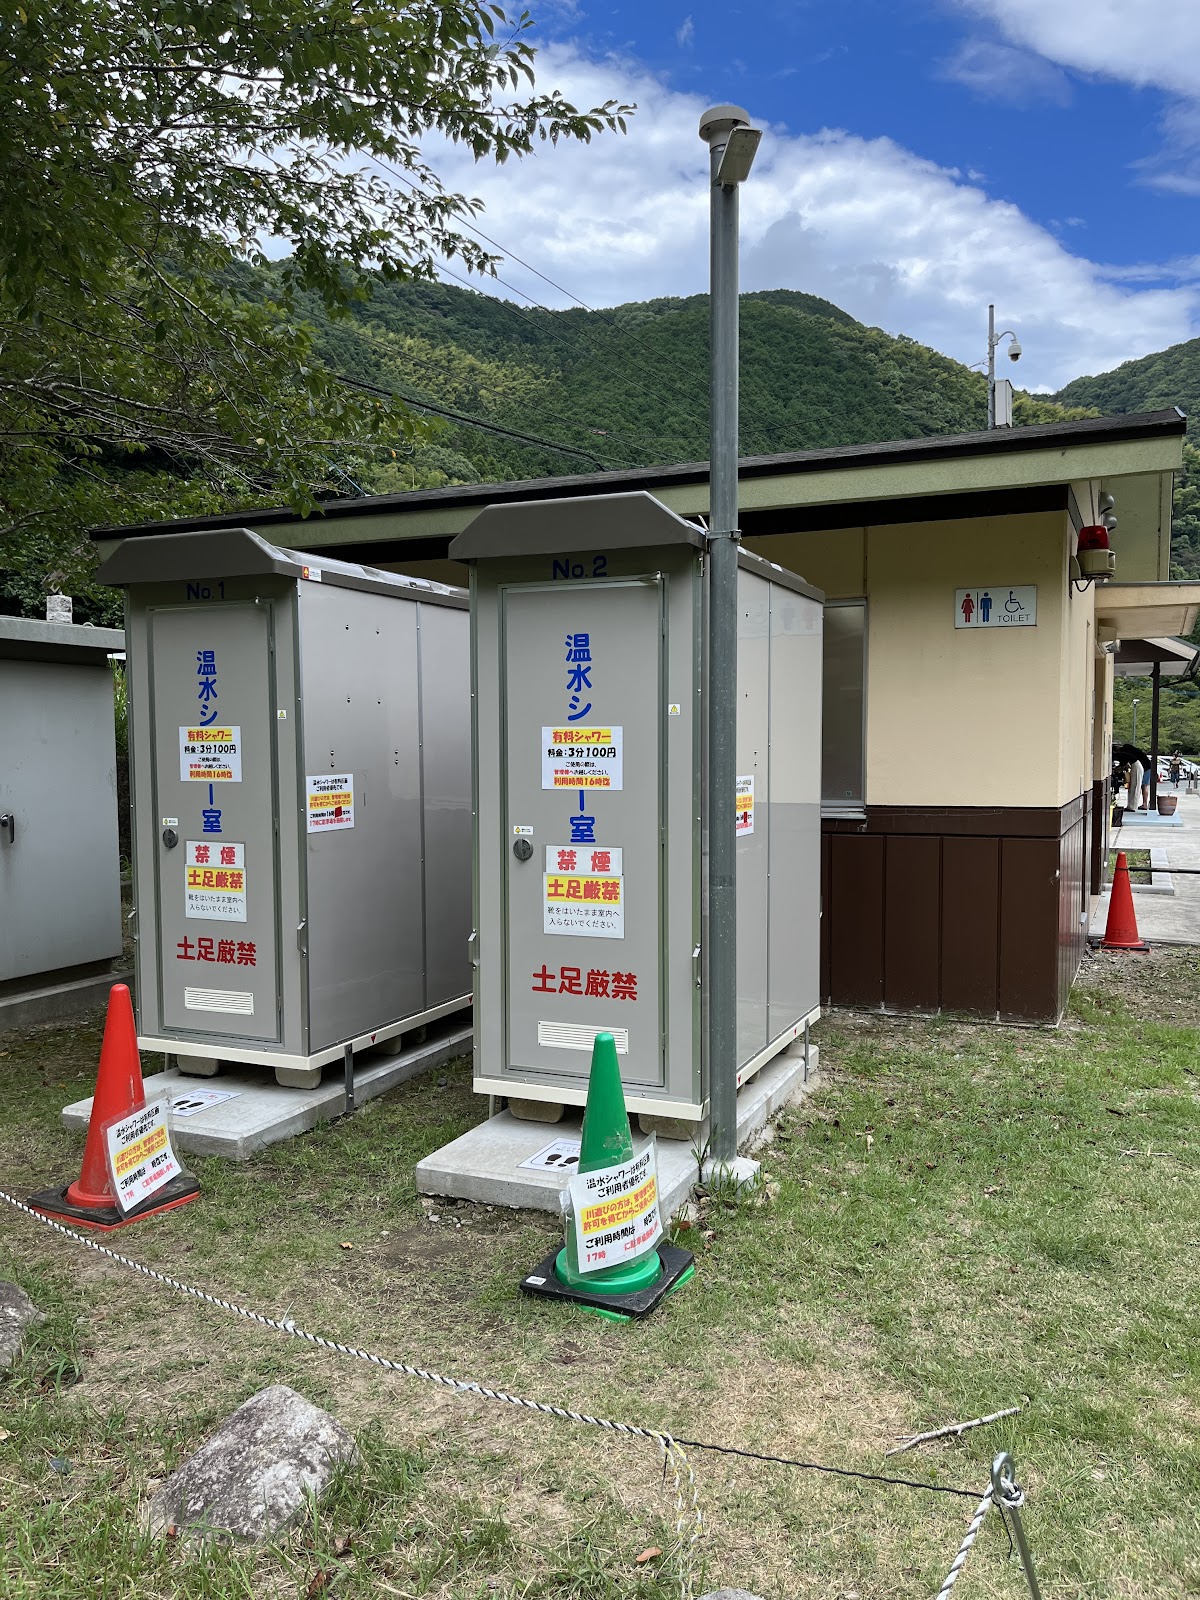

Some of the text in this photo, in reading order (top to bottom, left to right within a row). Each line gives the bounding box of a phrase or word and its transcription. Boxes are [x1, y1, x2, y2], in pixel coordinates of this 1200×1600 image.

[552, 555, 607, 580] No.2
[186, 581, 225, 600] No.1
[997, 614, 1030, 622] TOILET
[188, 730, 232, 741] 有料シャワー
[553, 730, 611, 743] 有料シャワー
[188, 869, 243, 889] 土足厳禁
[548, 878, 620, 900] 土足厳禁
[188, 893, 244, 904] 靴をはいたまま室内へ
[189, 904, 242, 913] 入らないでください。
[547, 906, 620, 918] 靴をはいたまま室内へ
[549, 917, 617, 929] 入らないでください。
[176, 935, 257, 967] 土足厳禁
[531, 964, 638, 1001] 土足厳禁
[585, 1225, 636, 1249] ご利用時間は
[586, 1250, 606, 1263] 17時
